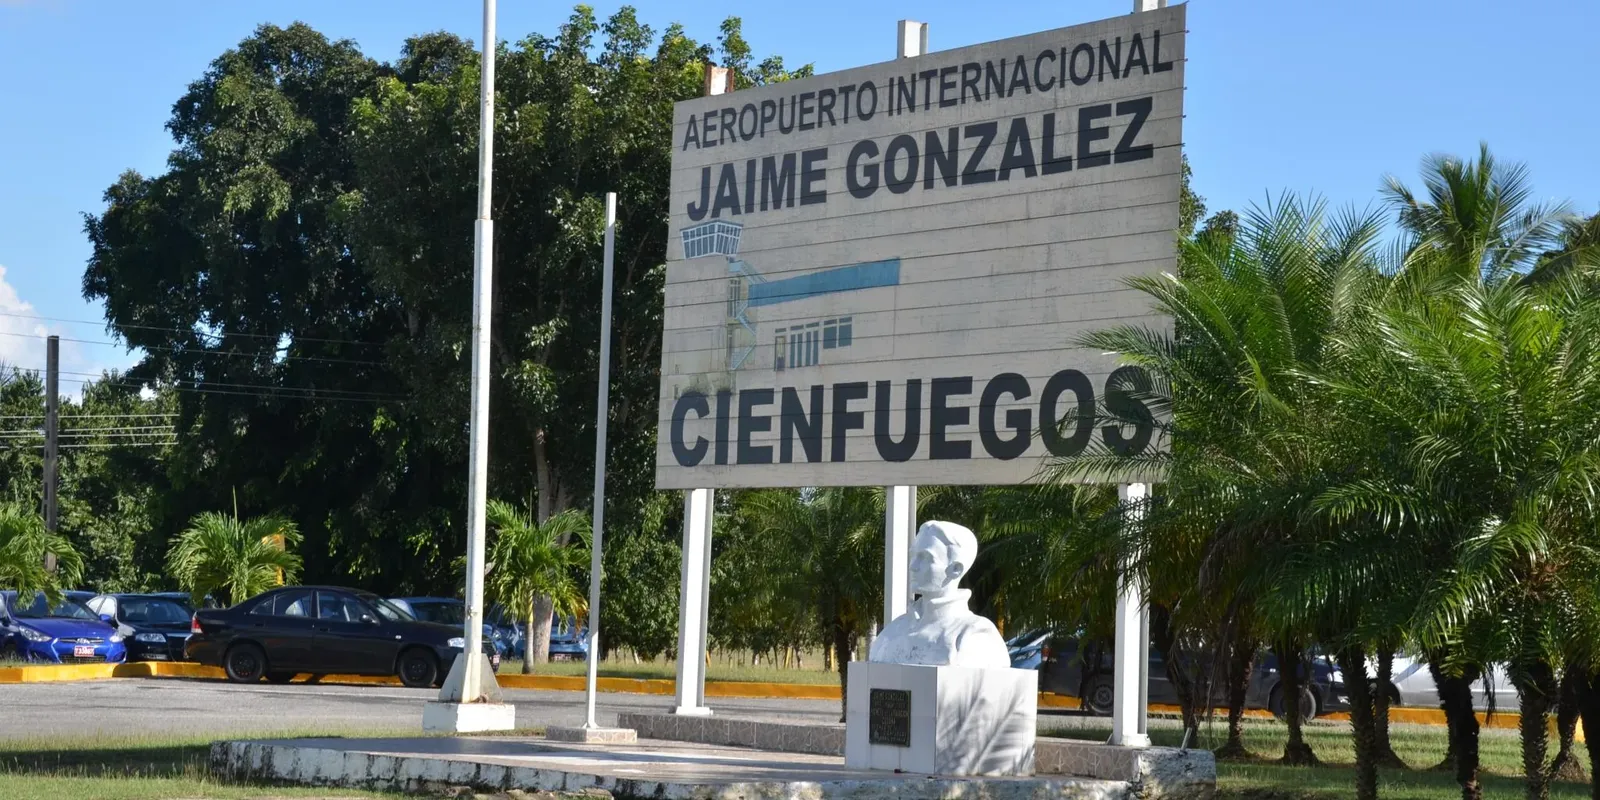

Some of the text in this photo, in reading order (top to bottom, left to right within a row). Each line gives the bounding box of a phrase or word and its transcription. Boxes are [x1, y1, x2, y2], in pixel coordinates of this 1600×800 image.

[683, 30, 1173, 151] AEROPUERTO INTERNACIONAL
[687, 96, 1153, 221] JAIME GONZALEZ
[670, 365, 1153, 467] CIENFUEGOS
